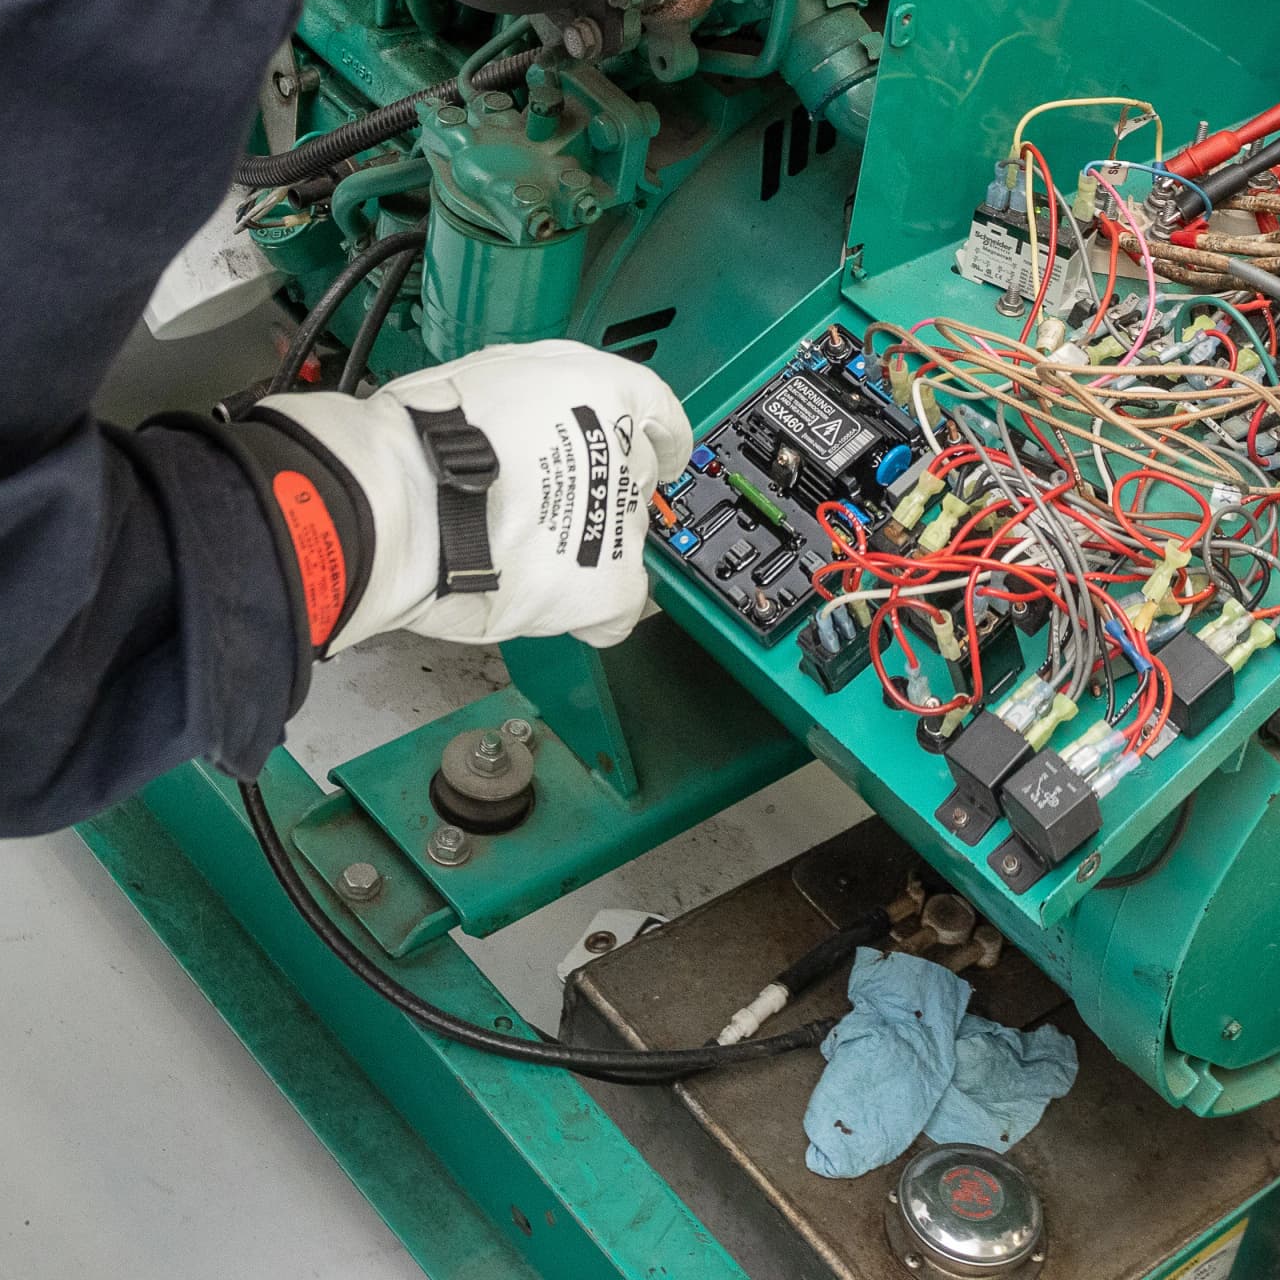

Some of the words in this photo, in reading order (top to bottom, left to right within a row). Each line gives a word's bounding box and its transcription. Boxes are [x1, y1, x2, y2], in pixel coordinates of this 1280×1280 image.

[768, 402, 805, 433] SX460
[792, 379, 836, 416] WARNING!
[555, 423, 576, 472] LEATHER
[585, 429, 608, 481] SIZE
[556, 476, 576, 555] PROTECTORS
[612, 465, 629, 560] SOLUTIONS
[323, 531, 340, 608] SALISBURY
